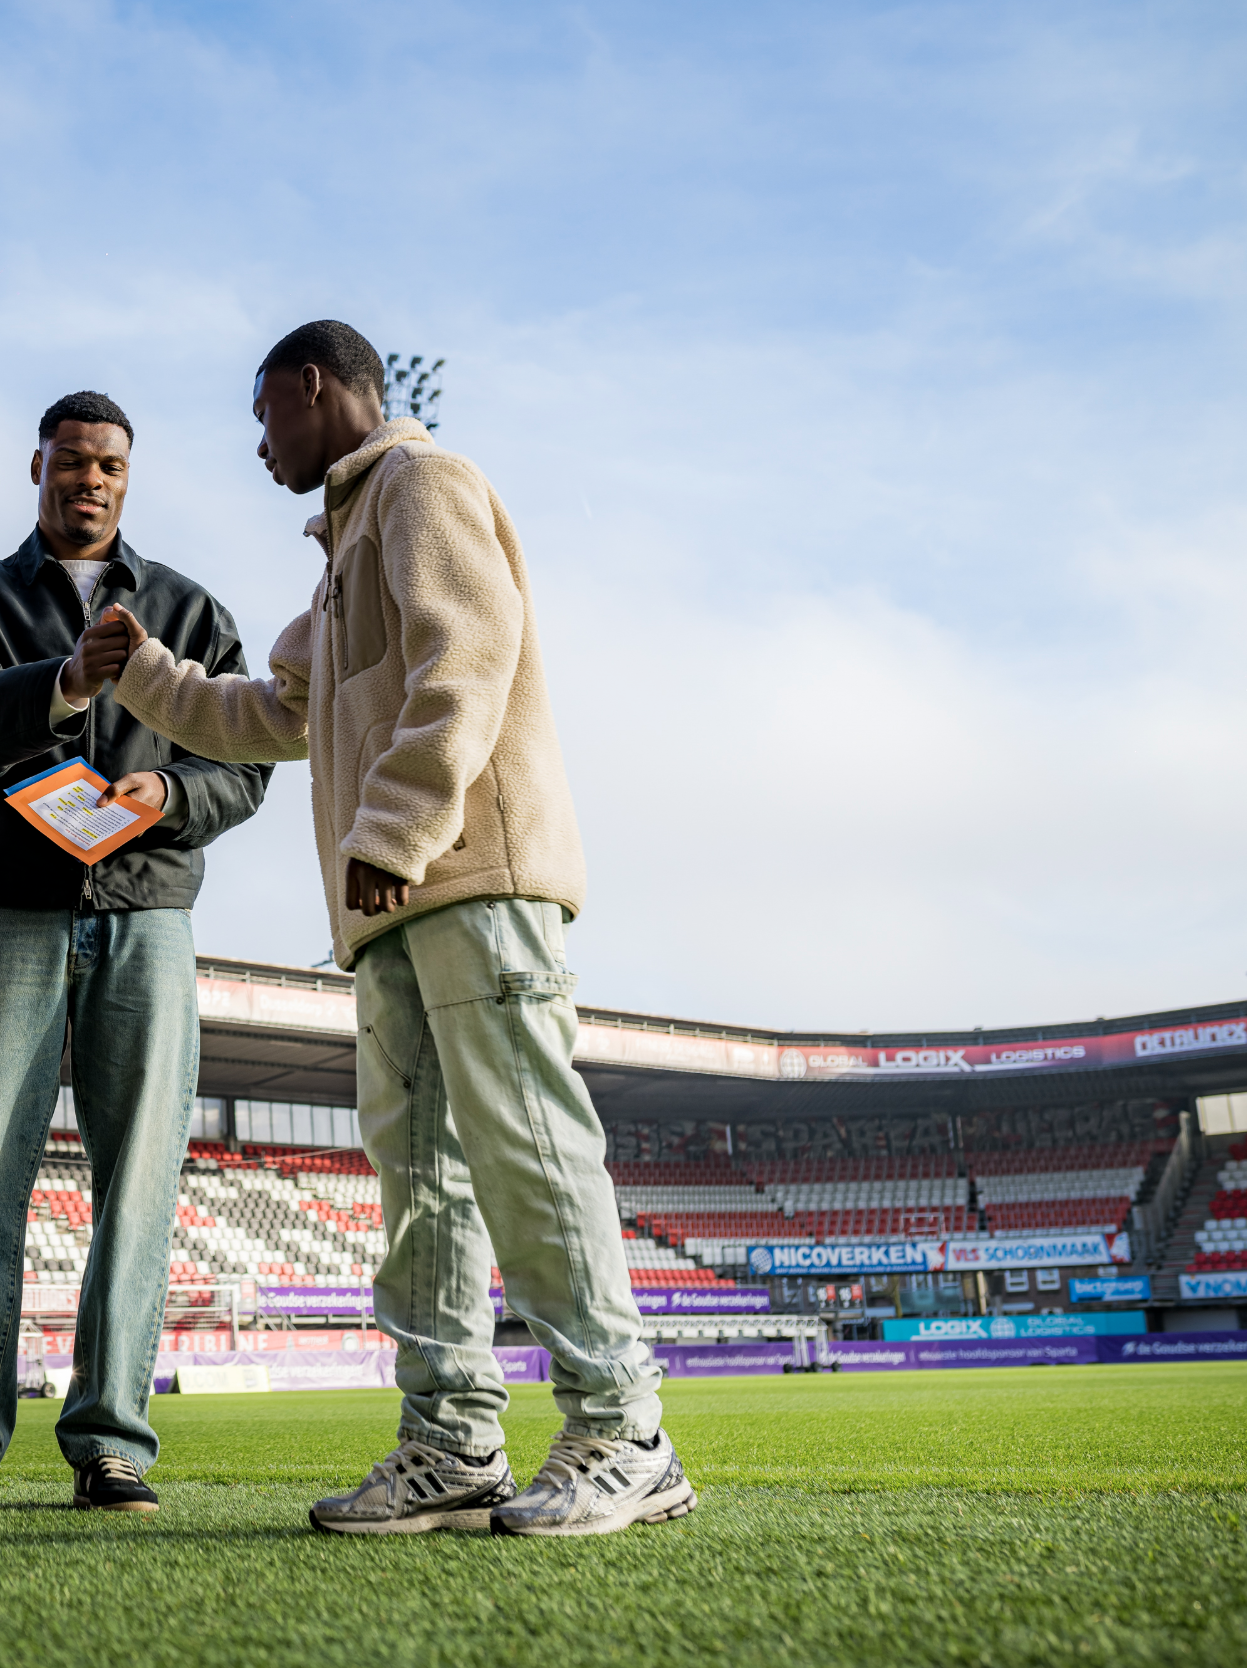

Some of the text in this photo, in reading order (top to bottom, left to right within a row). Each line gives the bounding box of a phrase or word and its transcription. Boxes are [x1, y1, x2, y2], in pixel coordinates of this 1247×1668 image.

[808, 1045, 1087, 1072] GLOBAL LOGIX LOGISTICS
[773, 1244, 926, 1267] NICOVERKEN
[984, 1241, 1102, 1263] SCHOONMAAK
[919, 1320, 988, 1338] LOGIX
